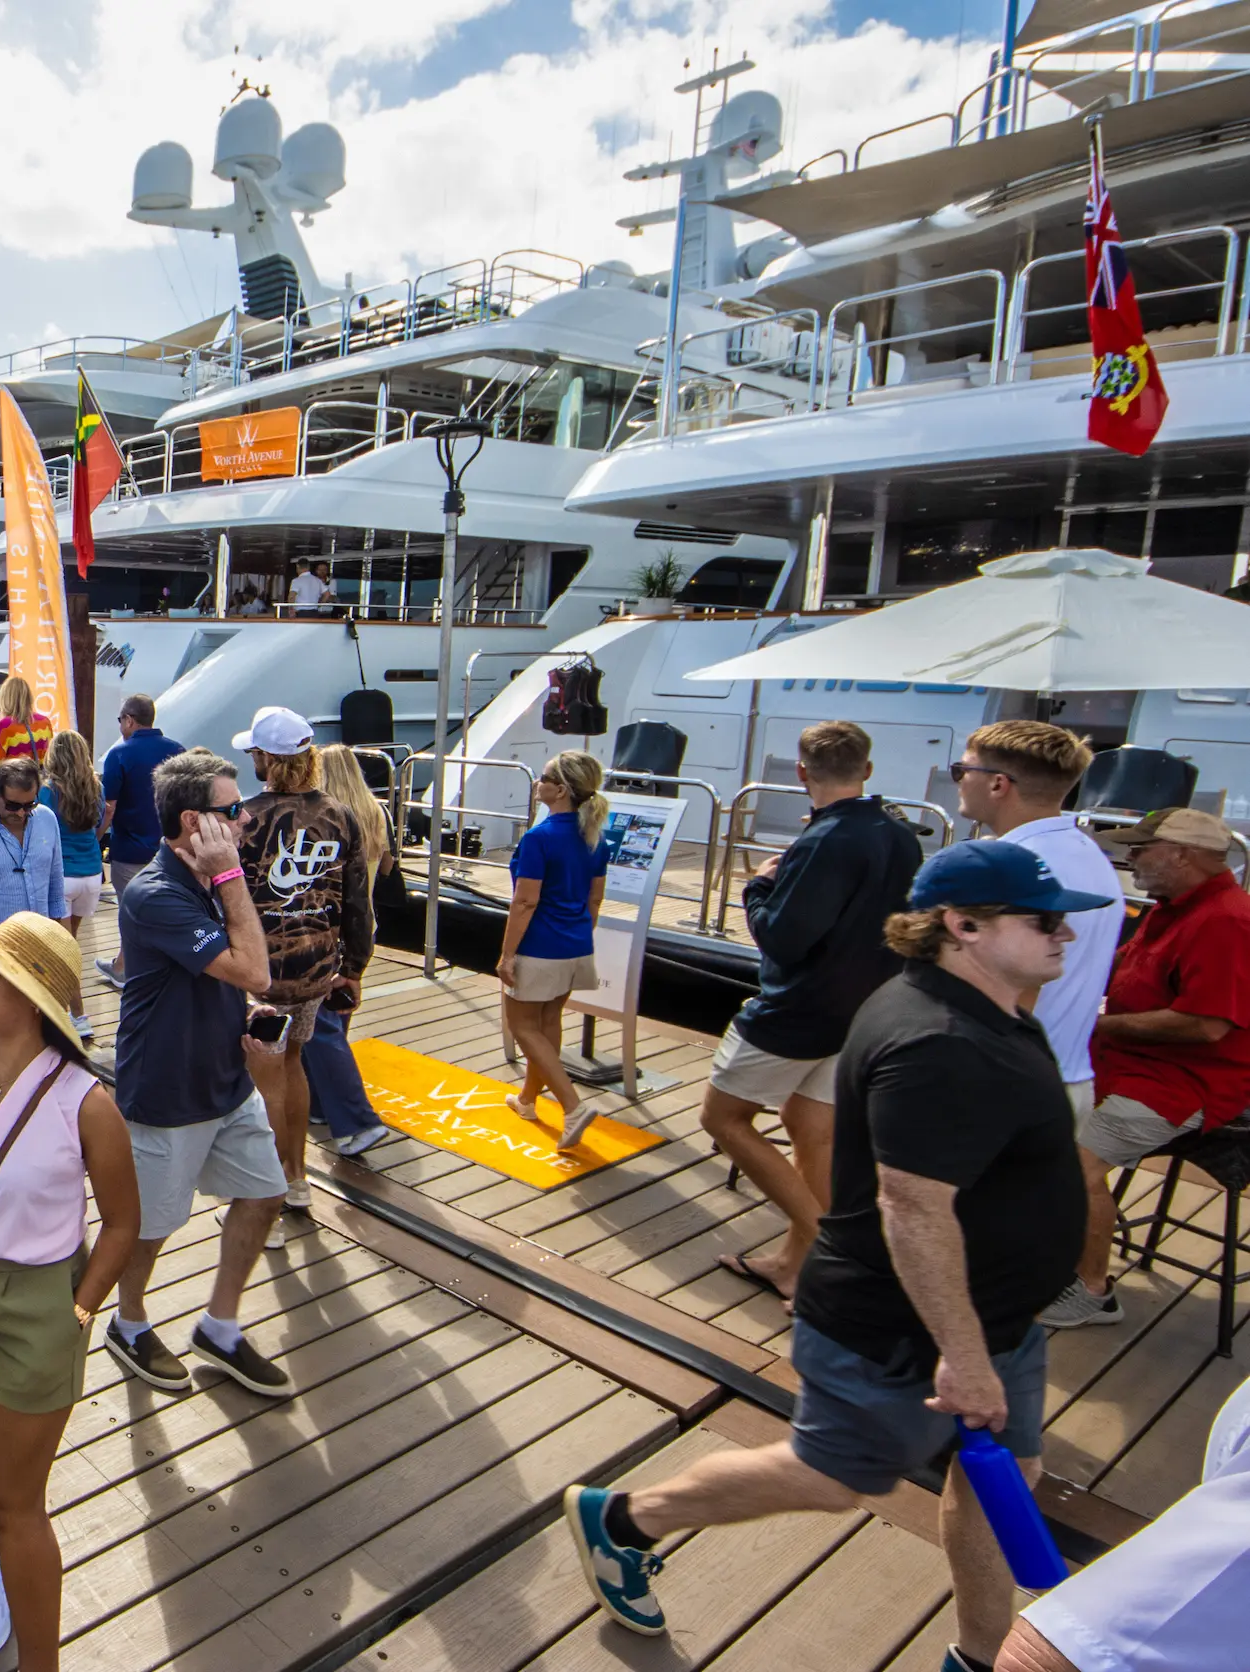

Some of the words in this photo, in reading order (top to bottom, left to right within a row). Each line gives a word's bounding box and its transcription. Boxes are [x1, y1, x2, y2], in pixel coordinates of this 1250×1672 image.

[213, 453, 246, 466] WORTH
[249, 449, 284, 463] AVENUE
[230, 464, 263, 475] YACHTS
[378, 1109, 462, 1146] CHTS
[418, 1108, 581, 1172] AVENUE
